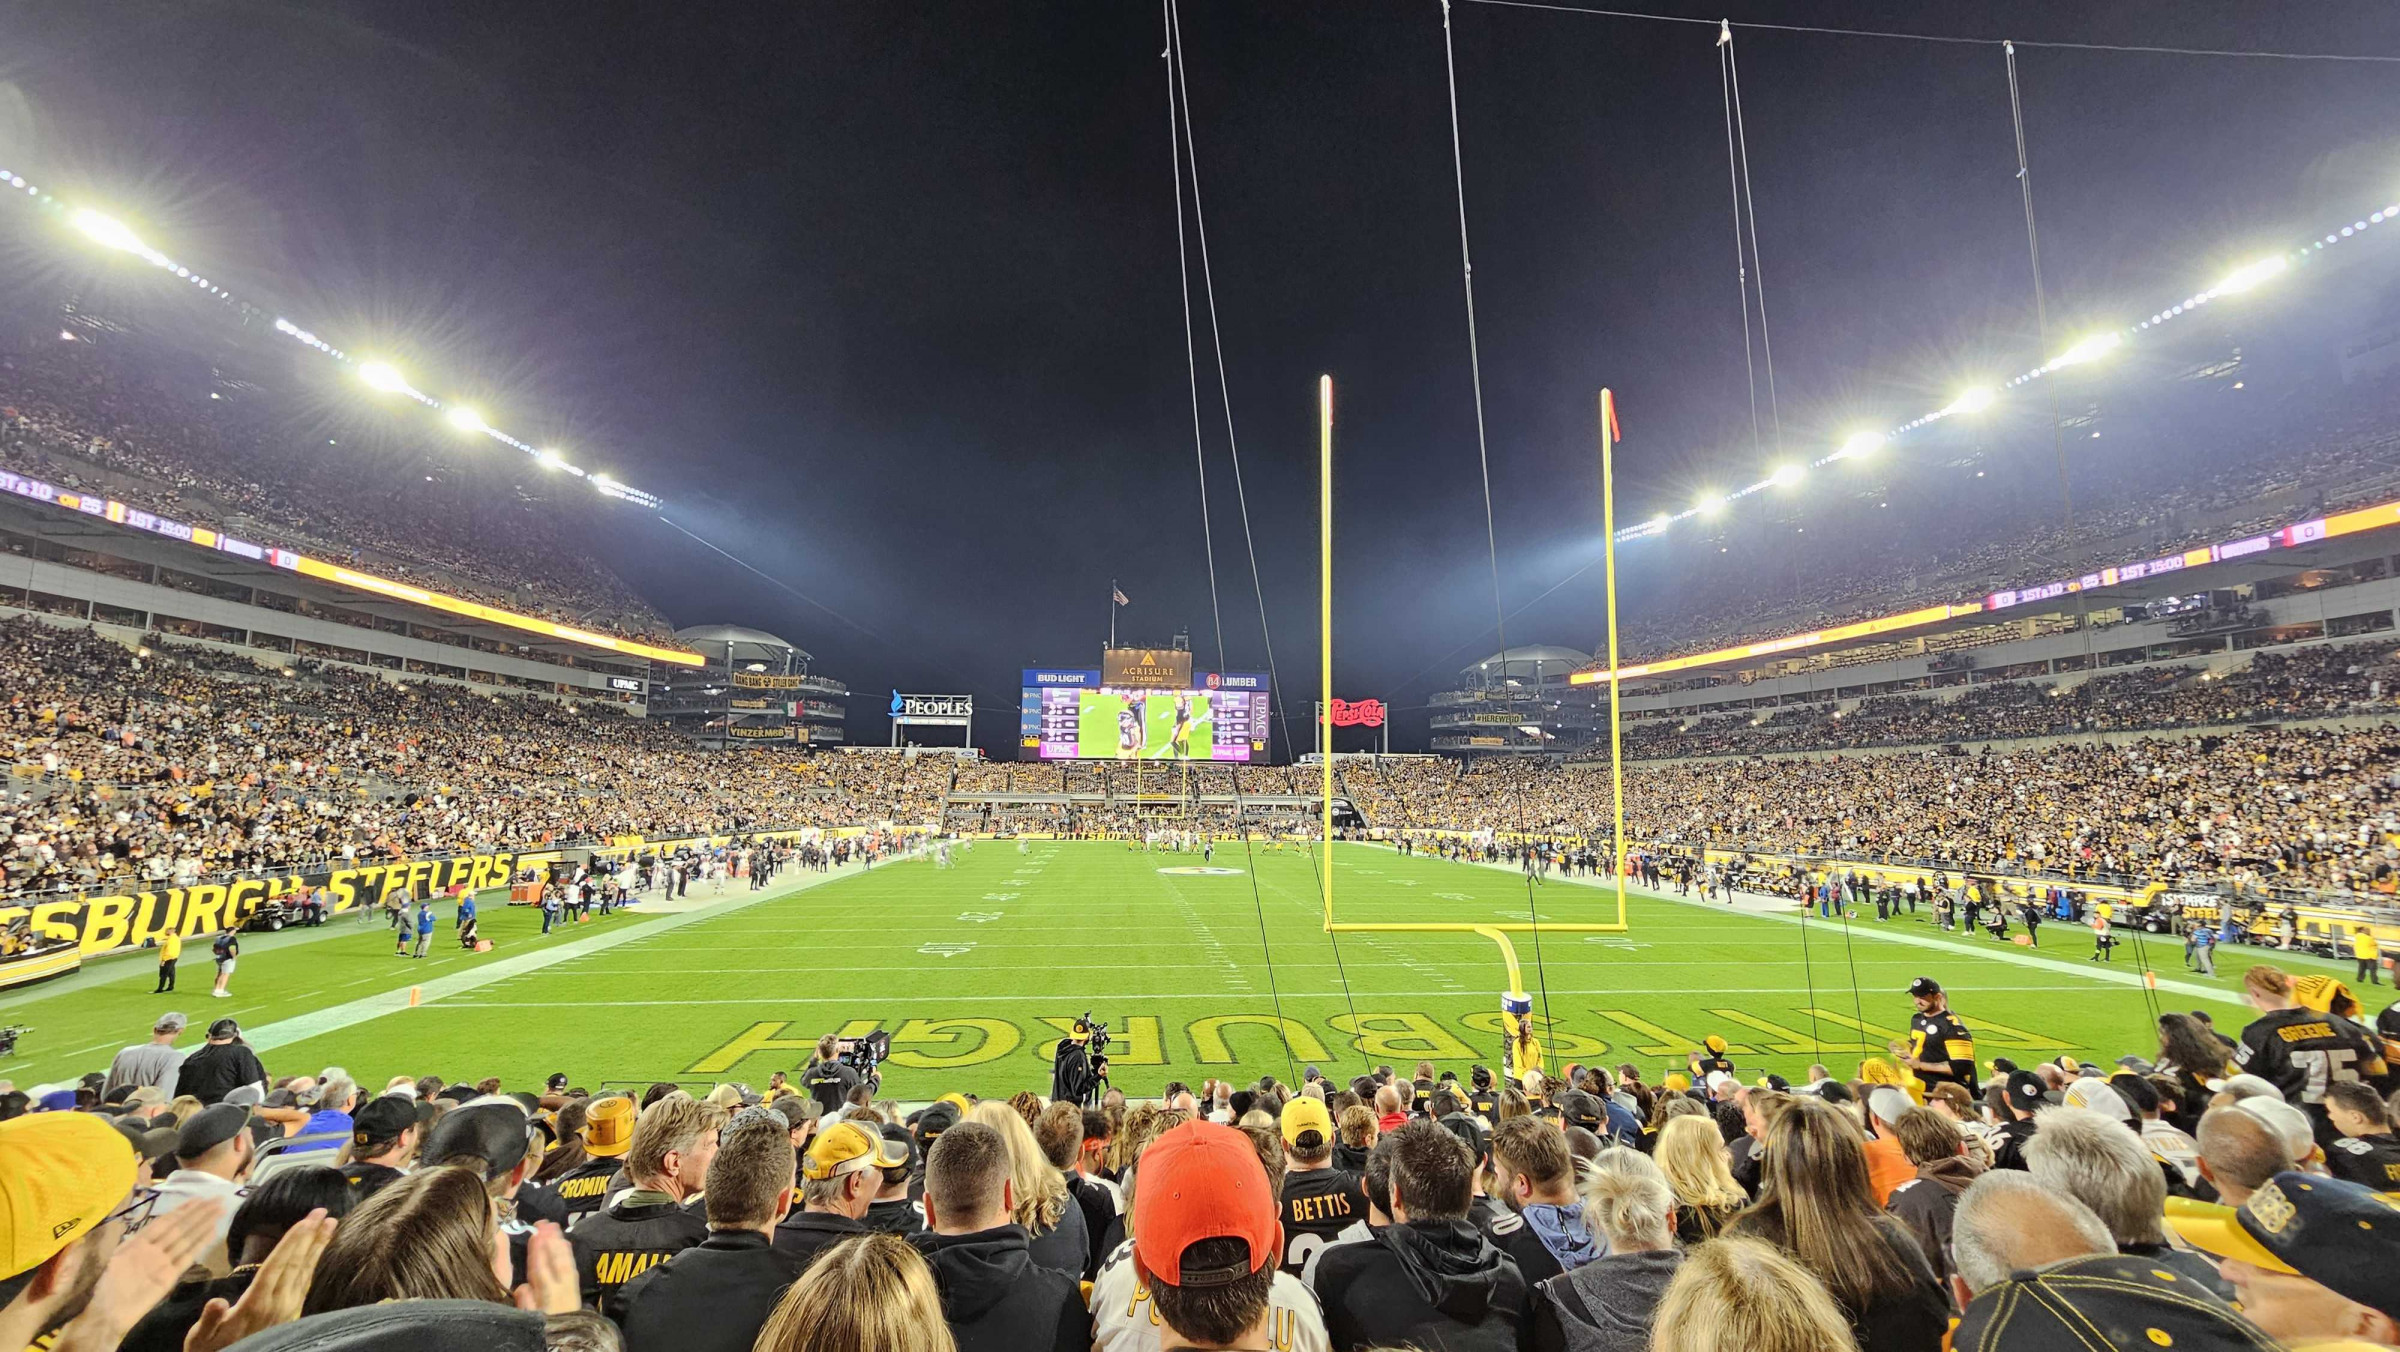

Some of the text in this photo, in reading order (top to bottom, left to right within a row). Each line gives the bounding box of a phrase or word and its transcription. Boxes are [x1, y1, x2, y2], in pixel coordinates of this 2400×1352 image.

[2121, 556, 2183, 580] 1ST 15:00
[1037, 674, 1085, 683] BUD LIGHT
[1122, 668, 1174, 676] ACRISURE
[1222, 677, 1257, 687] LUMBER
[613, 678, 638, 690] UPMC
[905, 699, 973, 715] PEOPLES
[1256, 696, 1266, 735] UPMC
[330, 853, 512, 912] STEELERS
[2277, 1022, 2337, 1043] GREENE
[1911, 1029, 1926, 1058] 7
[1292, 1192, 1350, 1222] BETTIS
